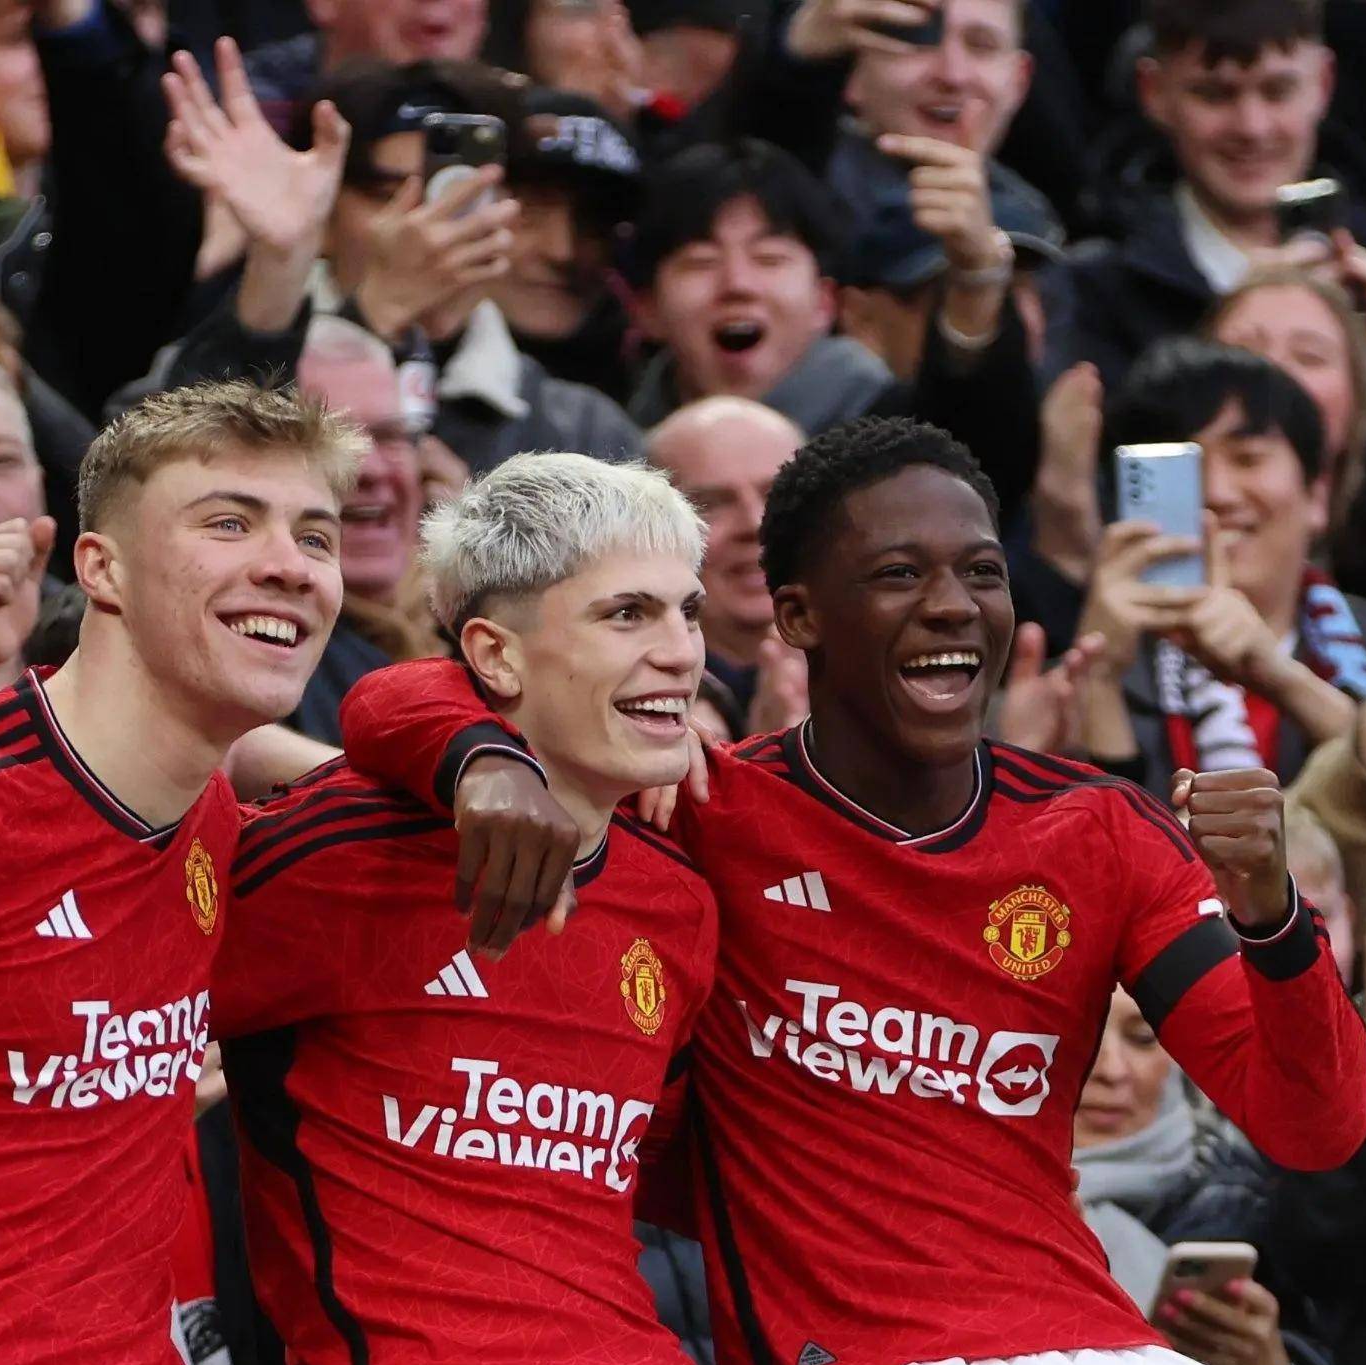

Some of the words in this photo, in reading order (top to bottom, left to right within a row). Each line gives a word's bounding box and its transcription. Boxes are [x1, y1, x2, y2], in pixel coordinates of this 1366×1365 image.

[994, 892, 1064, 924] MANCHESTER
[1001, 956, 1051, 974] UNITED
[71, 994, 193, 1063] Team
[736, 1000, 971, 1105] Viewer
[784, 978, 980, 1066] Team
[7, 1047, 188, 1110] Viewer
[450, 1056, 615, 1141] Team
[381, 1093, 606, 1180] Viewer
